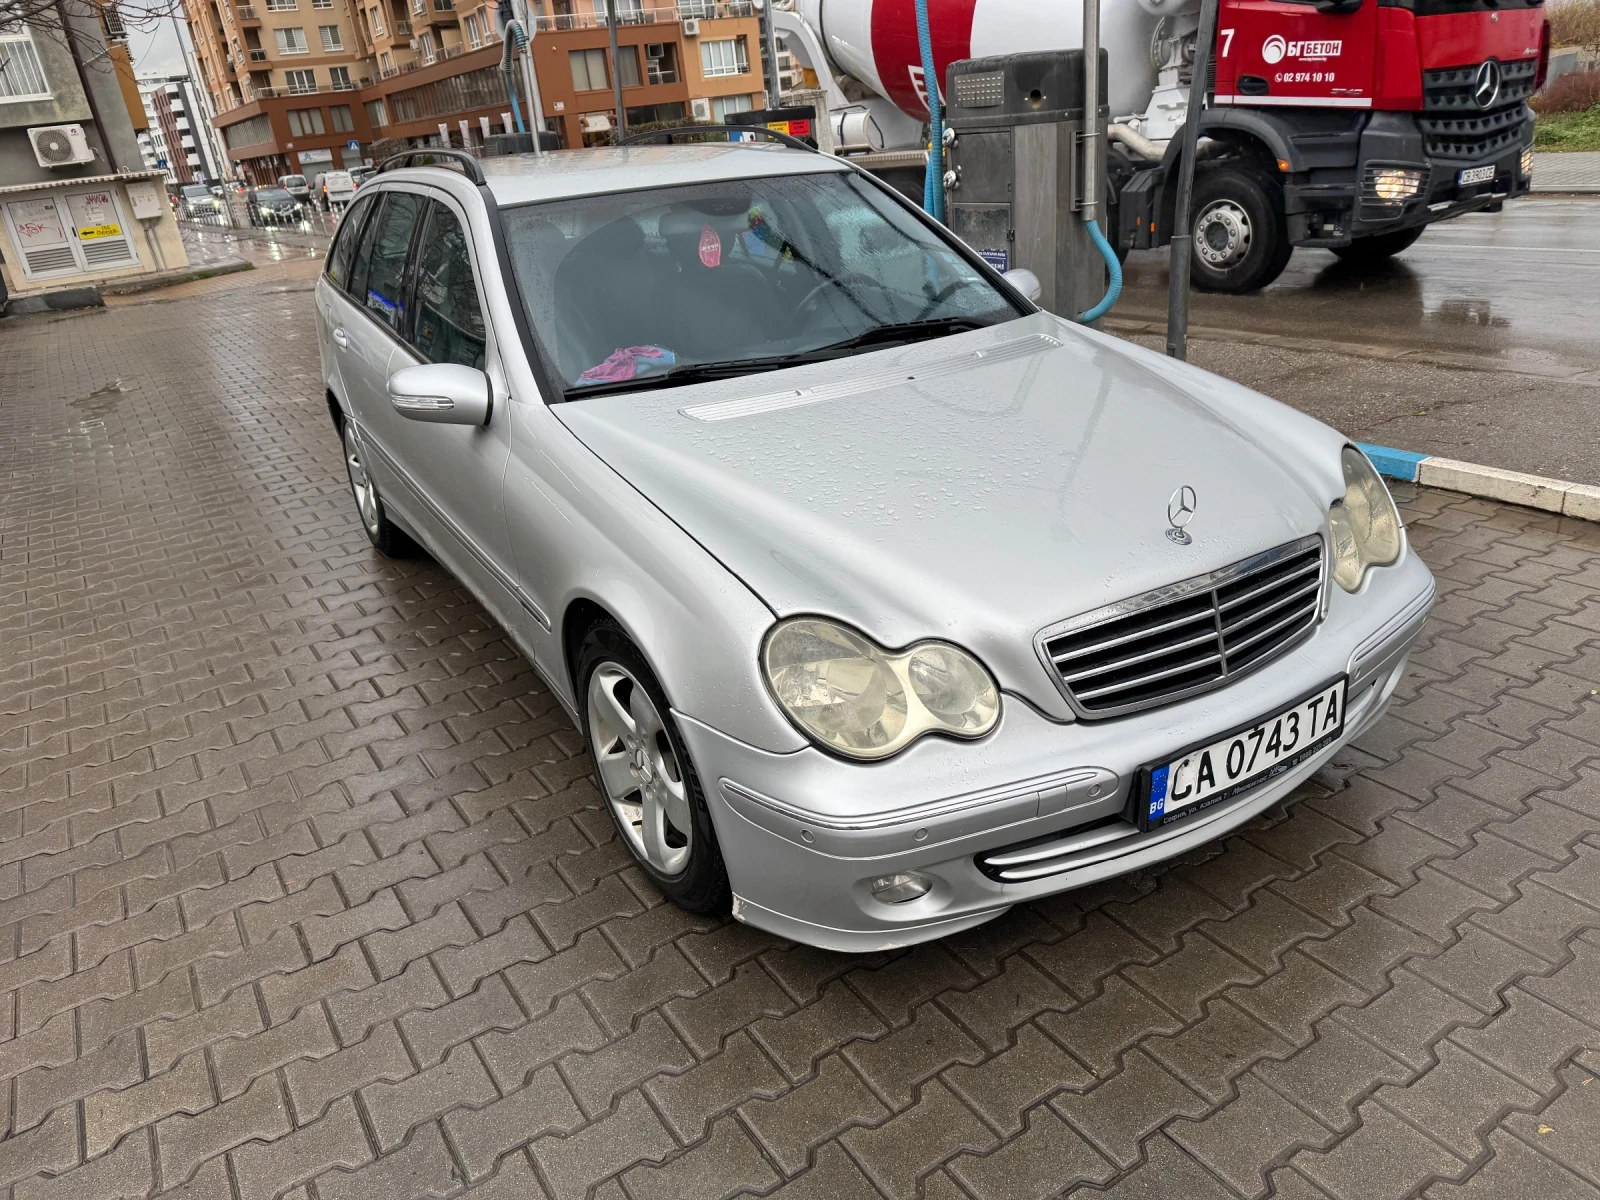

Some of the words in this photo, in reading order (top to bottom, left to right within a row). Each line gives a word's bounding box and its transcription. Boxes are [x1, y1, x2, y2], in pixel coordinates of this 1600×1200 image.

[1221, 28, 1235, 58] 7
[1283, 72, 1293, 83] 02
[1295, 72, 1310, 83] 974
[1312, 72, 1322, 83] 10
[1325, 72, 1335, 83] 10
[1170, 750, 1216, 801] CA
[1226, 711, 1300, 780] 0743
[1307, 689, 1338, 738] TA
[1150, 797, 1164, 815] BG
